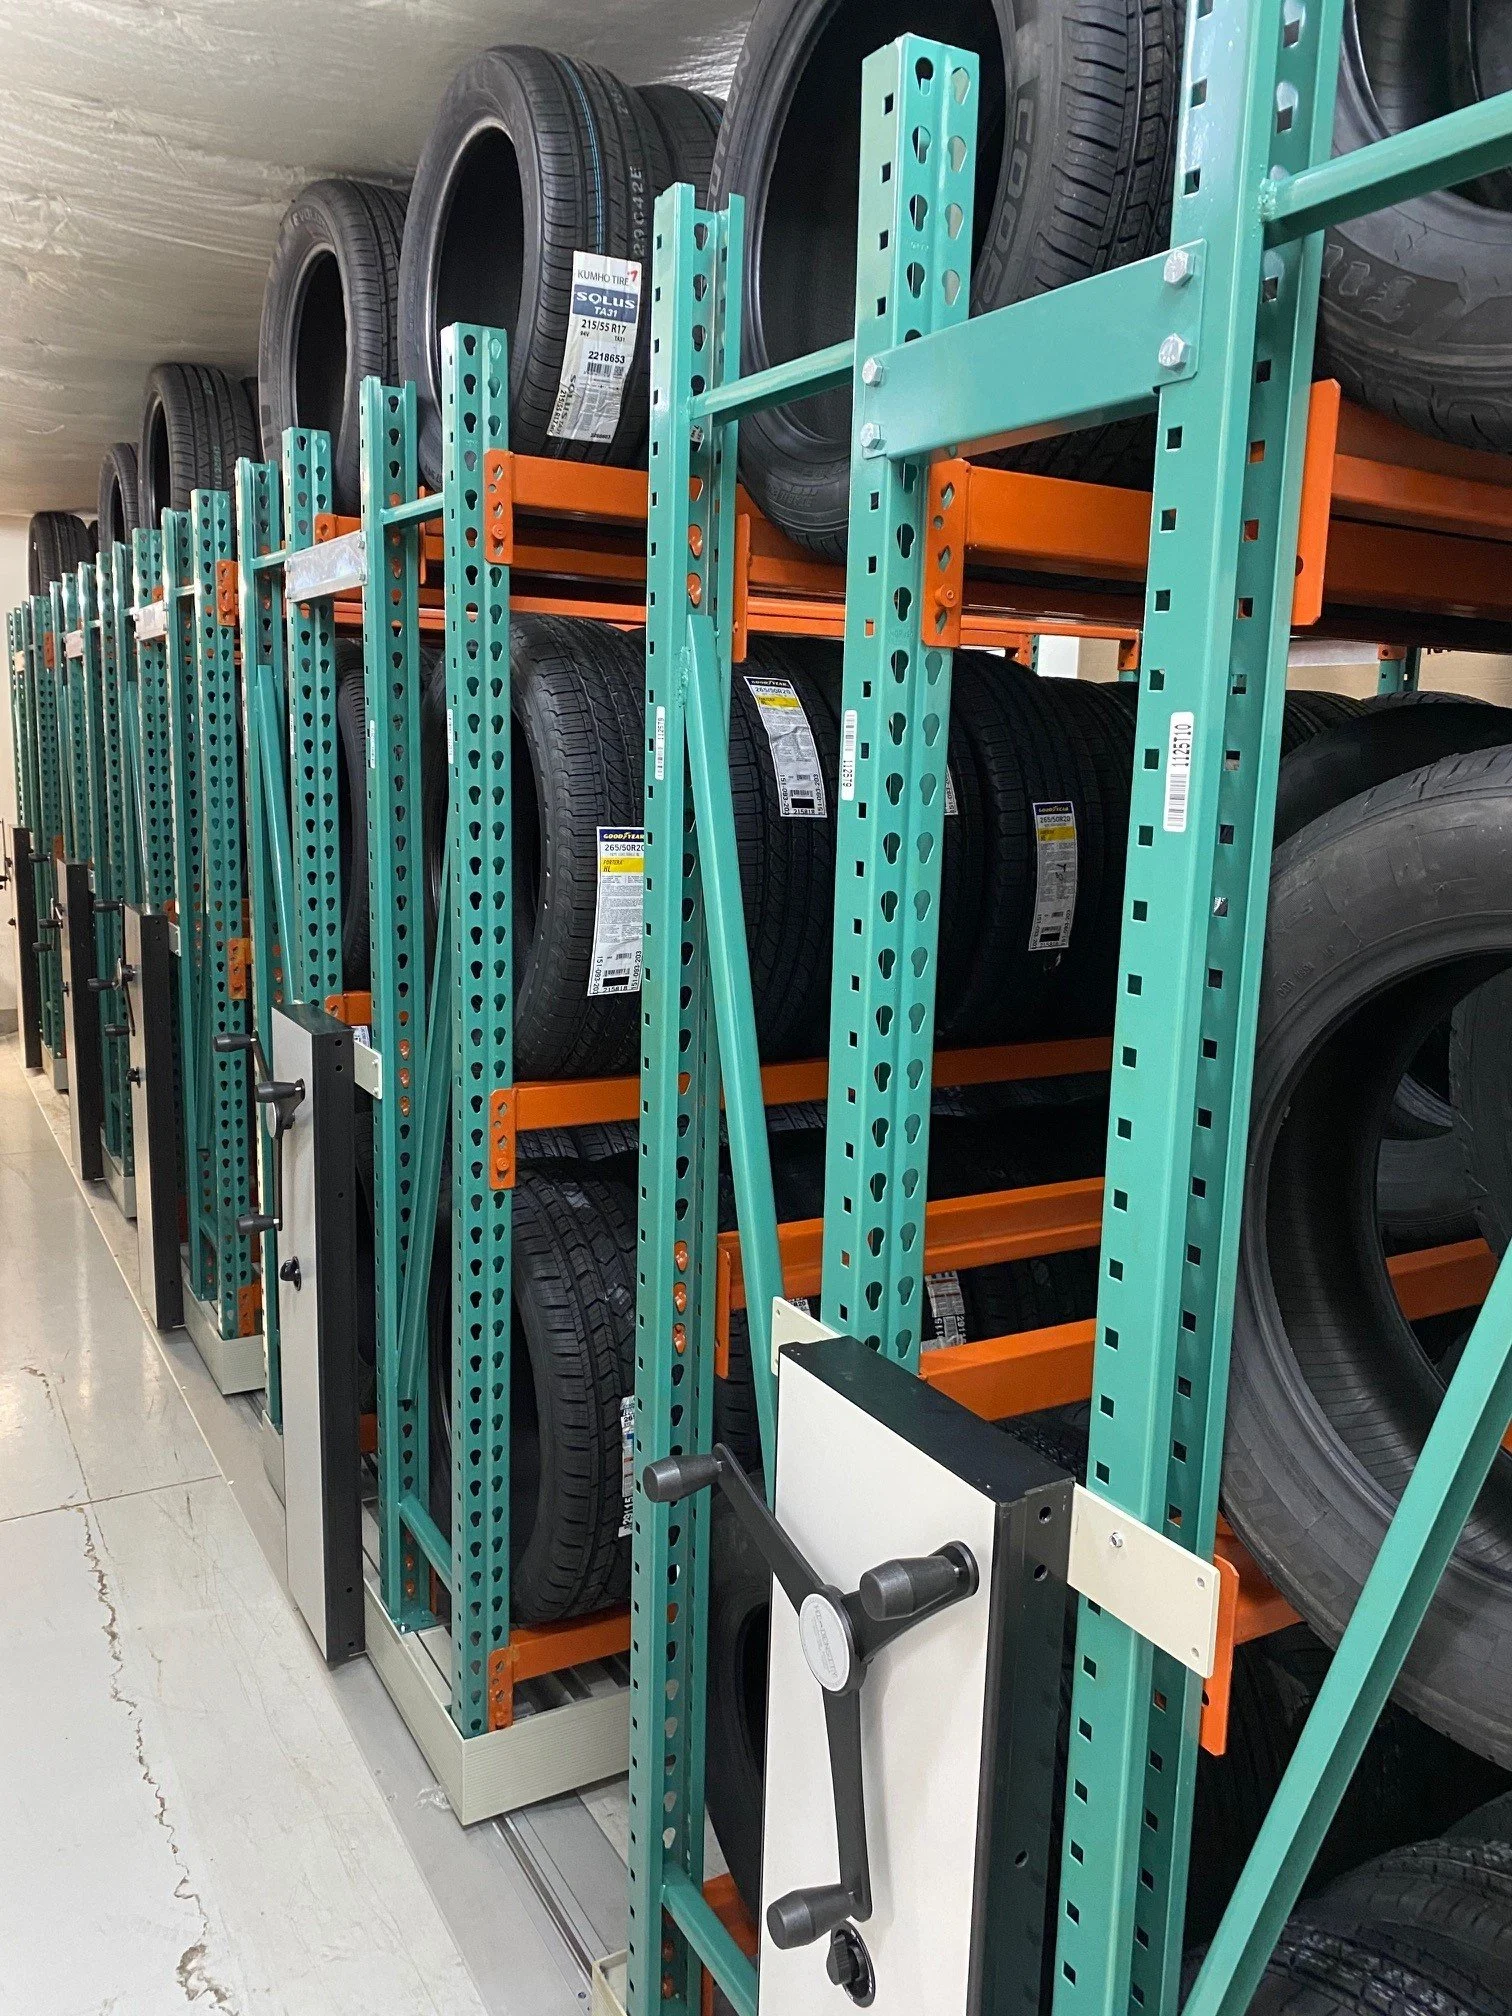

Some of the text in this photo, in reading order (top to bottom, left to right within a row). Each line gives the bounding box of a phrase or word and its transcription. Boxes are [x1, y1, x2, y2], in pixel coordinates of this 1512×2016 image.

[577, 269, 629, 286] KUMHO TIRE
[576, 291, 635, 309] SOLUS
[594, 306, 618, 317] TA31
[581, 319, 626, 334] 215/55 R17
[588, 351, 625, 363] 2218653
[1172, 724, 1191, 767] 1125T10
[843, 760, 852, 787] 1125T9
